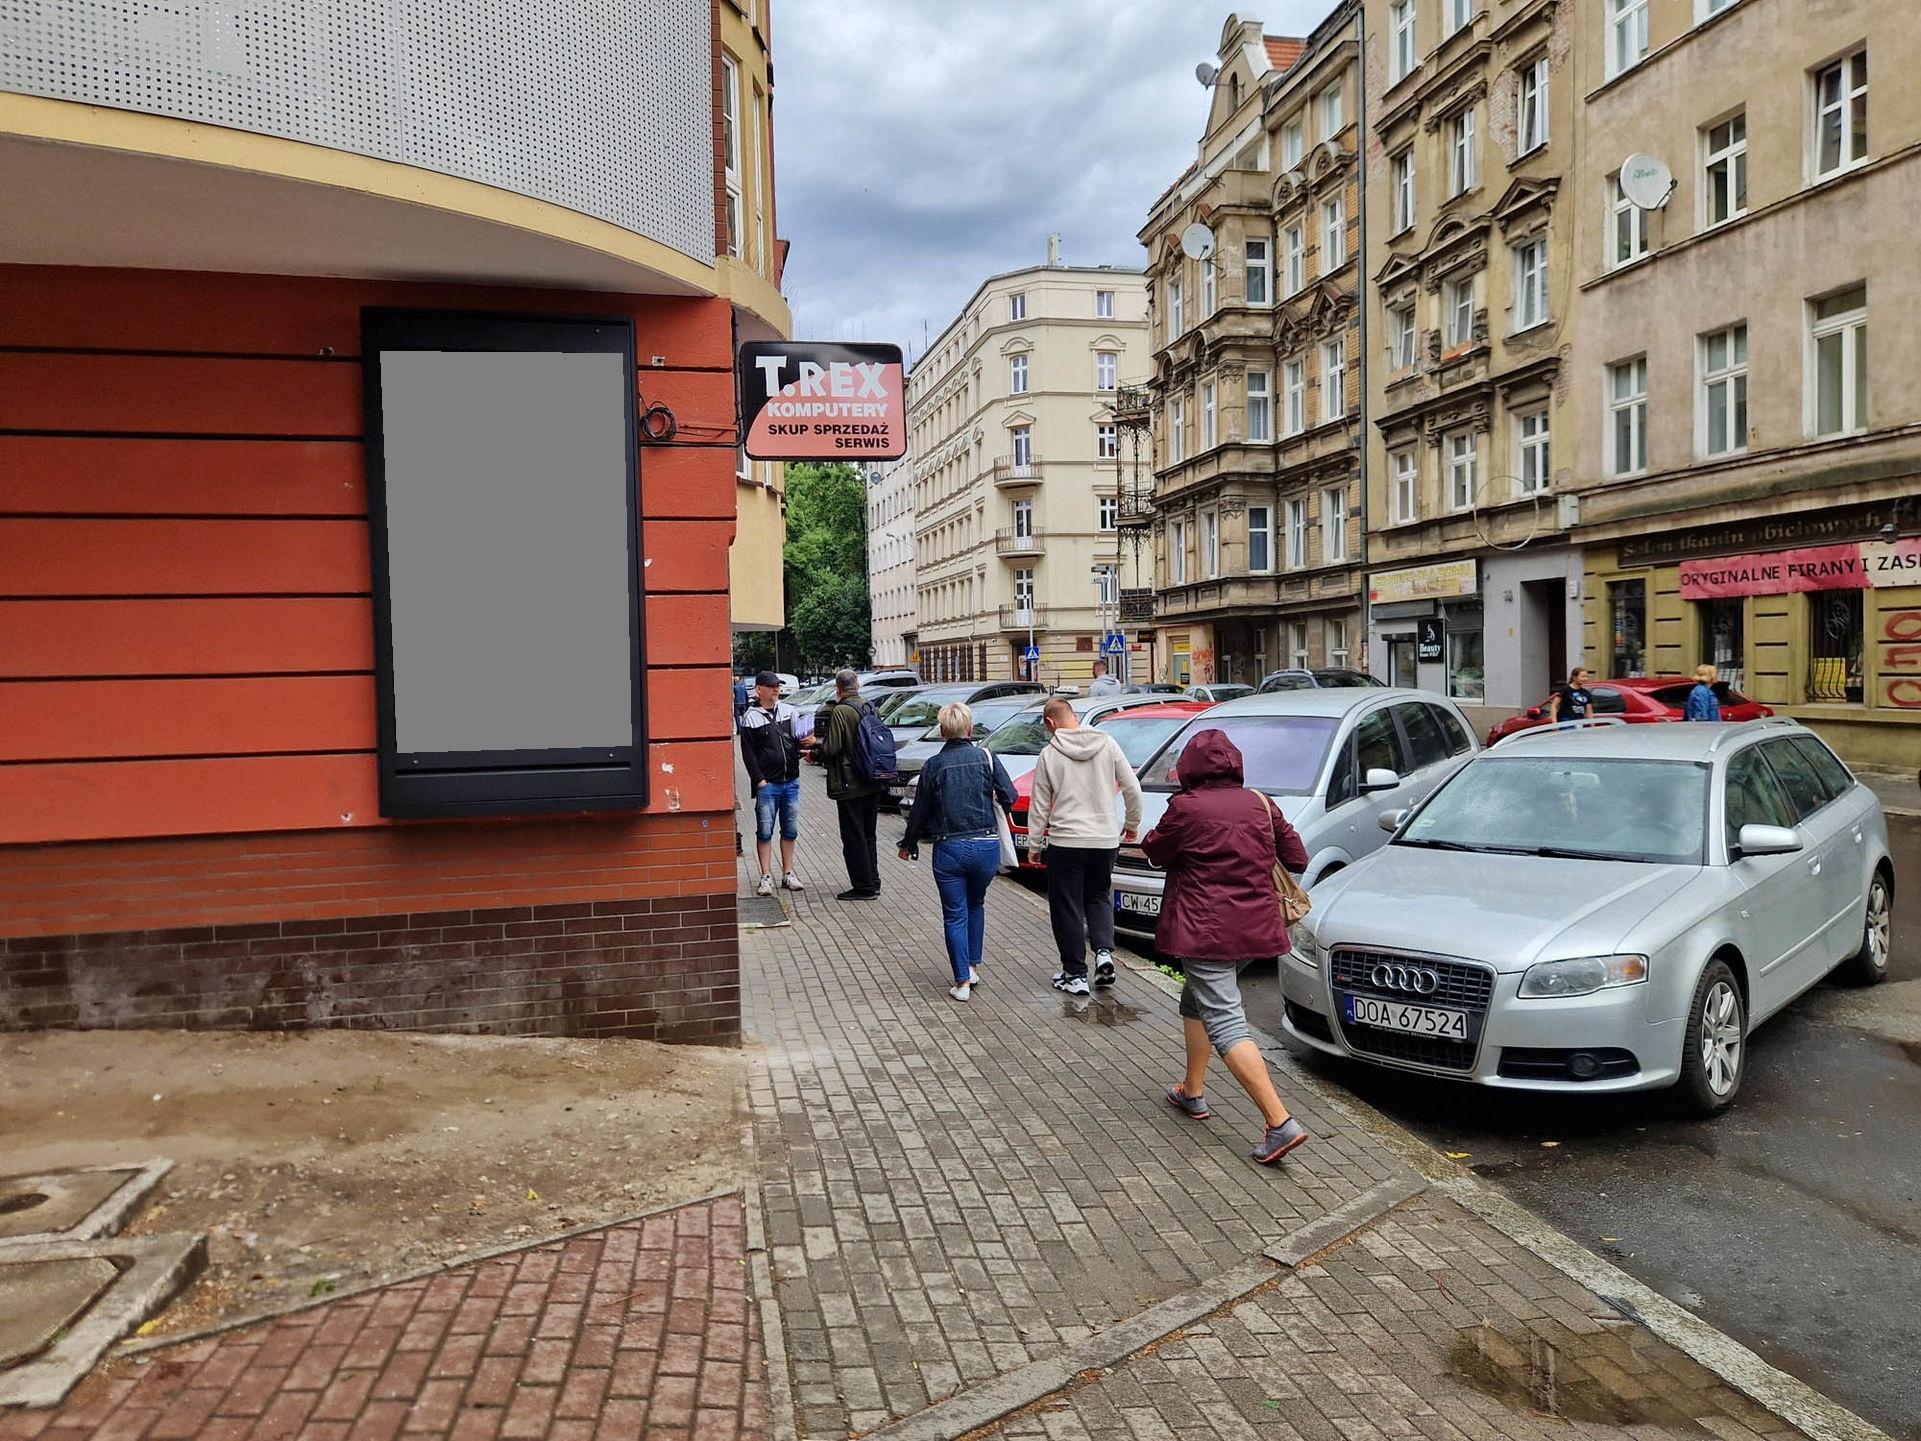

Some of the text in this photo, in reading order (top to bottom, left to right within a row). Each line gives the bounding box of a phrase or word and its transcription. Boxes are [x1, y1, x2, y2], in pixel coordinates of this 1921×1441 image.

[755, 355, 888, 399] T.REX
[767, 403, 889, 418] KOMPUTERY
[768, 422, 890, 435] SKUP SPRZEDAŻ
[835, 437, 890, 449] SERWIS
[1681, 553, 1921, 586] ORYGINALNE FIRANY I ZAS
[1122, 894, 1139, 909] CW
[1355, 999, 1465, 1037] DOA 67524
